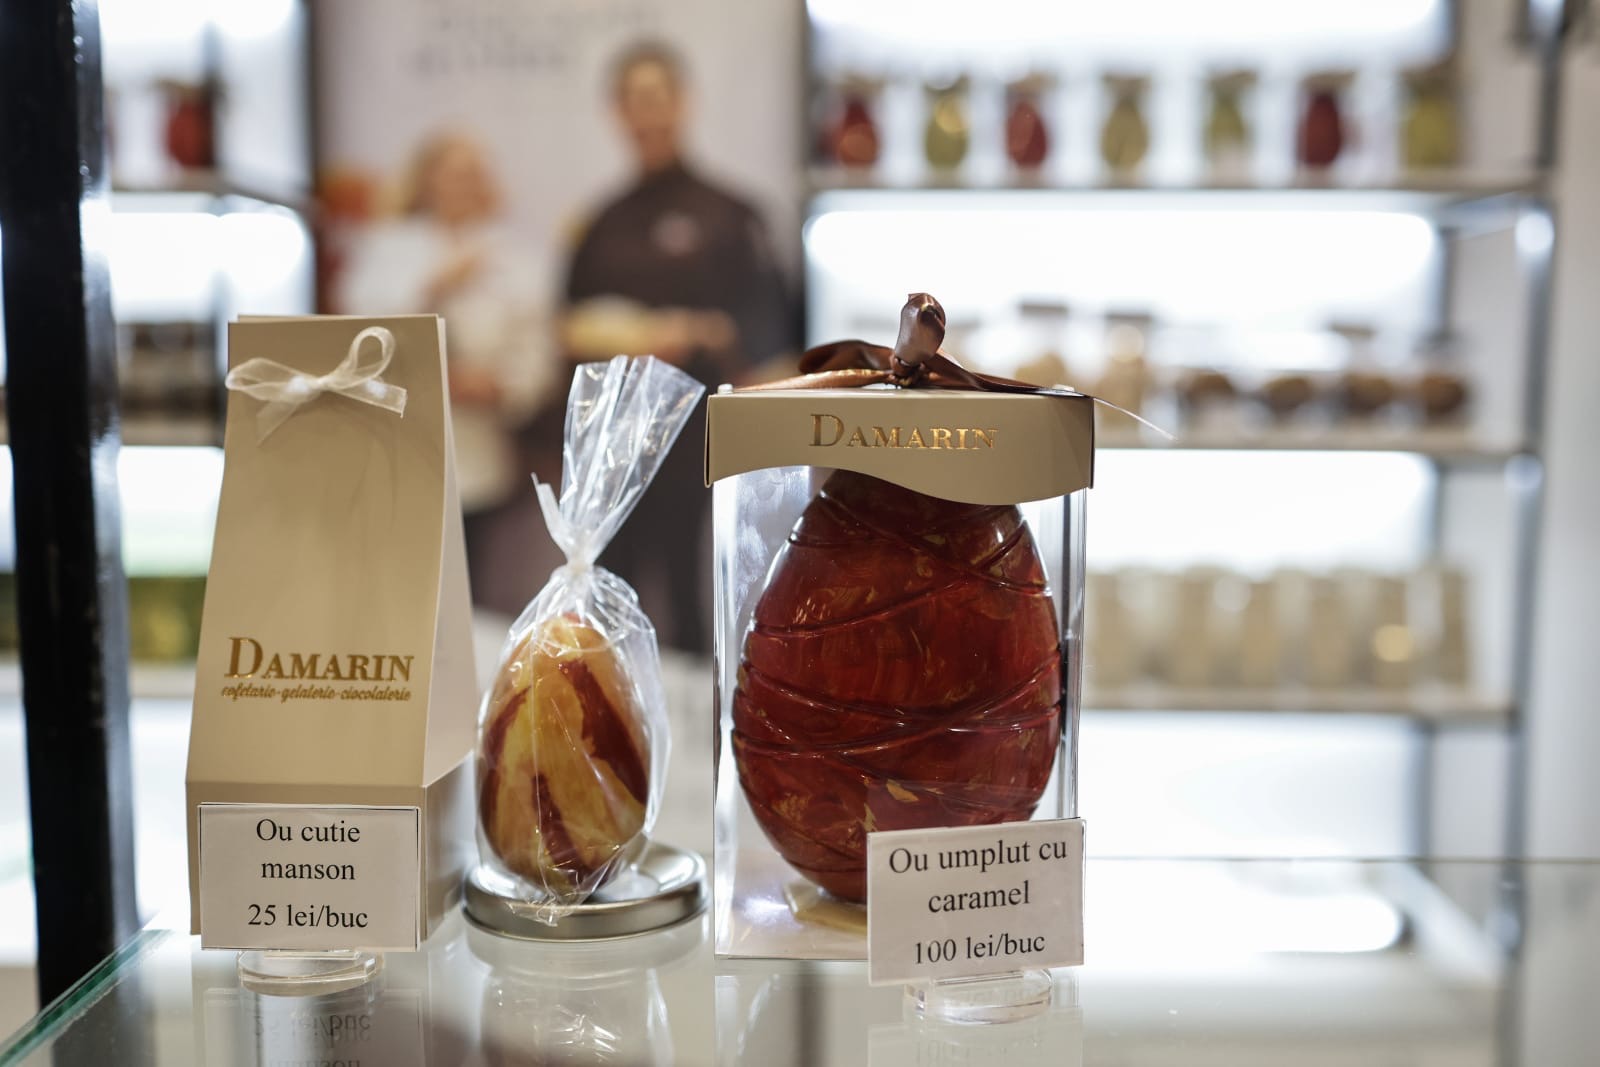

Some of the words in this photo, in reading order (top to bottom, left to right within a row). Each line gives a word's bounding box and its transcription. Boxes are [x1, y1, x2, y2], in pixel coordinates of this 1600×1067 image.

[809, 413, 999, 450] DAMARIN
[224, 636, 415, 682] DAMARIN
[256, 818, 292, 842] Ou
[300, 820, 361, 843] cutie
[260, 861, 356, 881] manson
[889, 847, 928, 874] Ou
[939, 839, 1030, 873] umplut
[1039, 840, 1067, 861] cu
[928, 879, 1030, 913] caramel
[247, 903, 277, 926] 25
[287, 904, 369, 928] lei/buc
[915, 939, 957, 965] 100
[966, 932, 1046, 959] lei/buc
